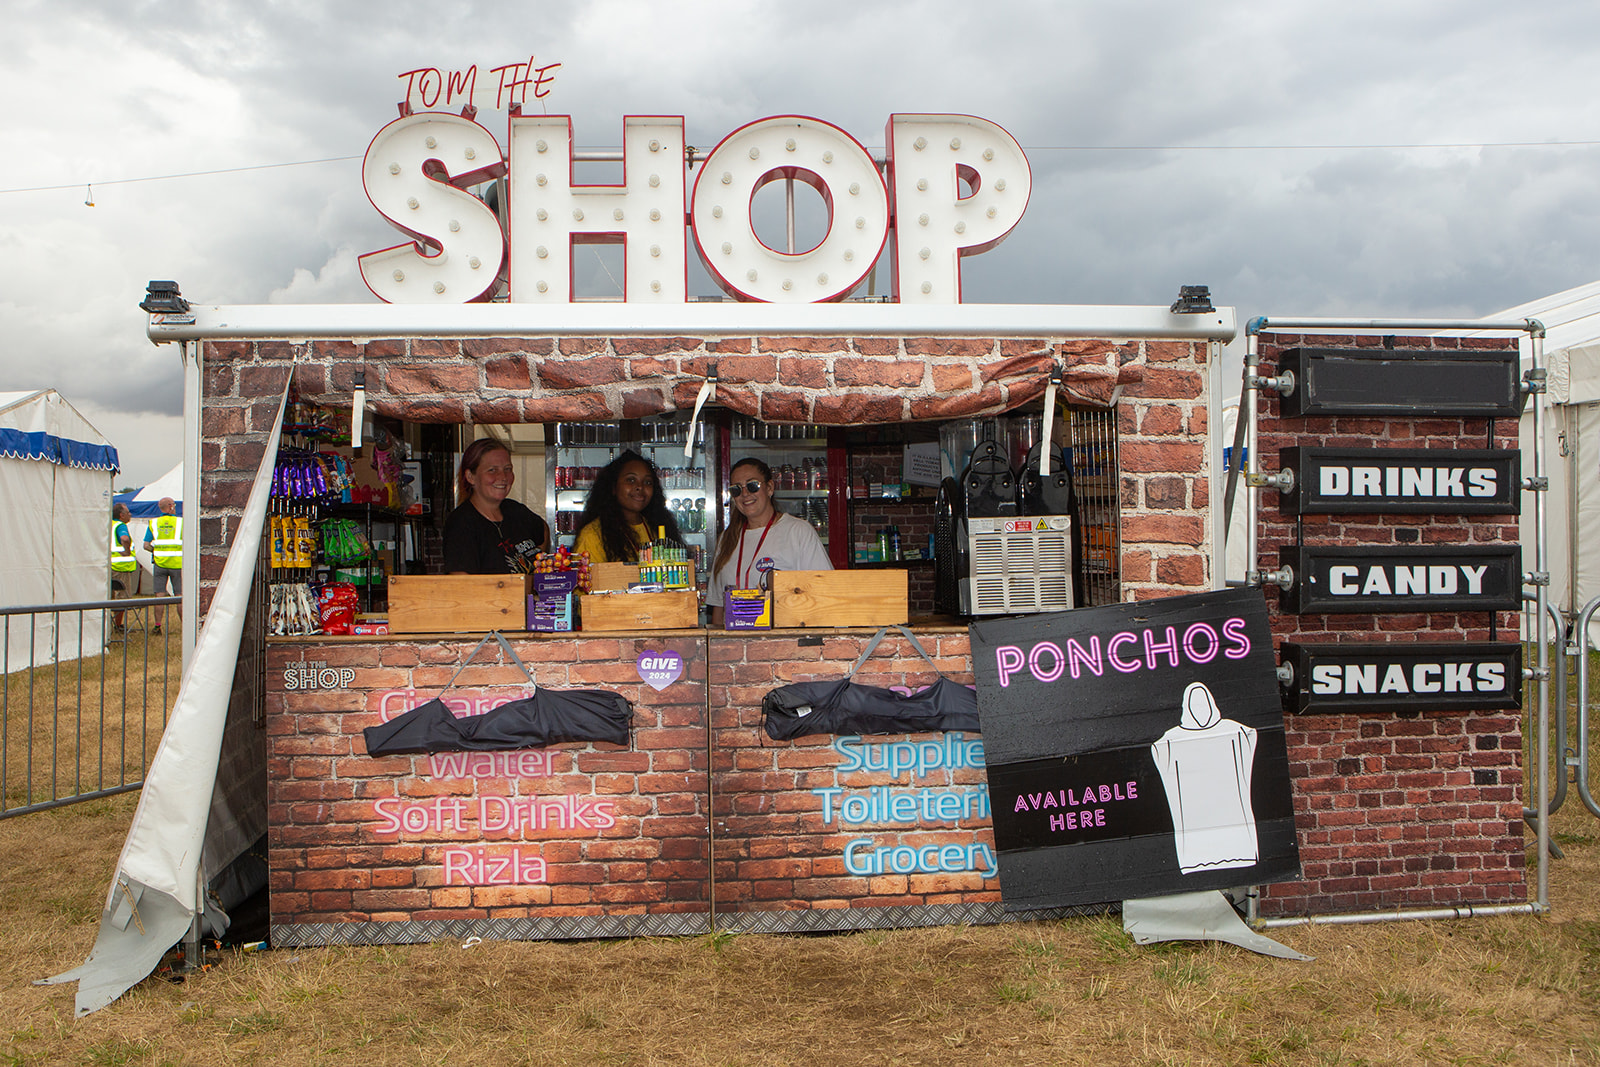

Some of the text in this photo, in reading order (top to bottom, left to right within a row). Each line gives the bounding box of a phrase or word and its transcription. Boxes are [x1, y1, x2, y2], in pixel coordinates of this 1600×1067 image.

[397, 55, 562, 115] TOM THE
[358, 111, 1033, 304] SHOP
[1319, 466, 1498, 497] DRINKS
[1328, 565, 1489, 596] CANDY
[284, 660, 327, 669] TOM THE
[640, 657, 679, 670] GIVE
[996, 617, 1251, 687] PONCHOS
[283, 668, 356, 690] SHOP
[648, 672, 671, 680] 2024
[1312, 662, 1506, 695] SNACKS
[834, 732, 987, 779] Supplie
[811, 783, 991, 824] Toileteri
[1014, 781, 1138, 812] AVAILABLE
[374, 794, 616, 834] Soft Drinks
[1049, 808, 1106, 832] HERE
[444, 848, 548, 885] Rizla
[844, 838, 999, 879] Grocery
